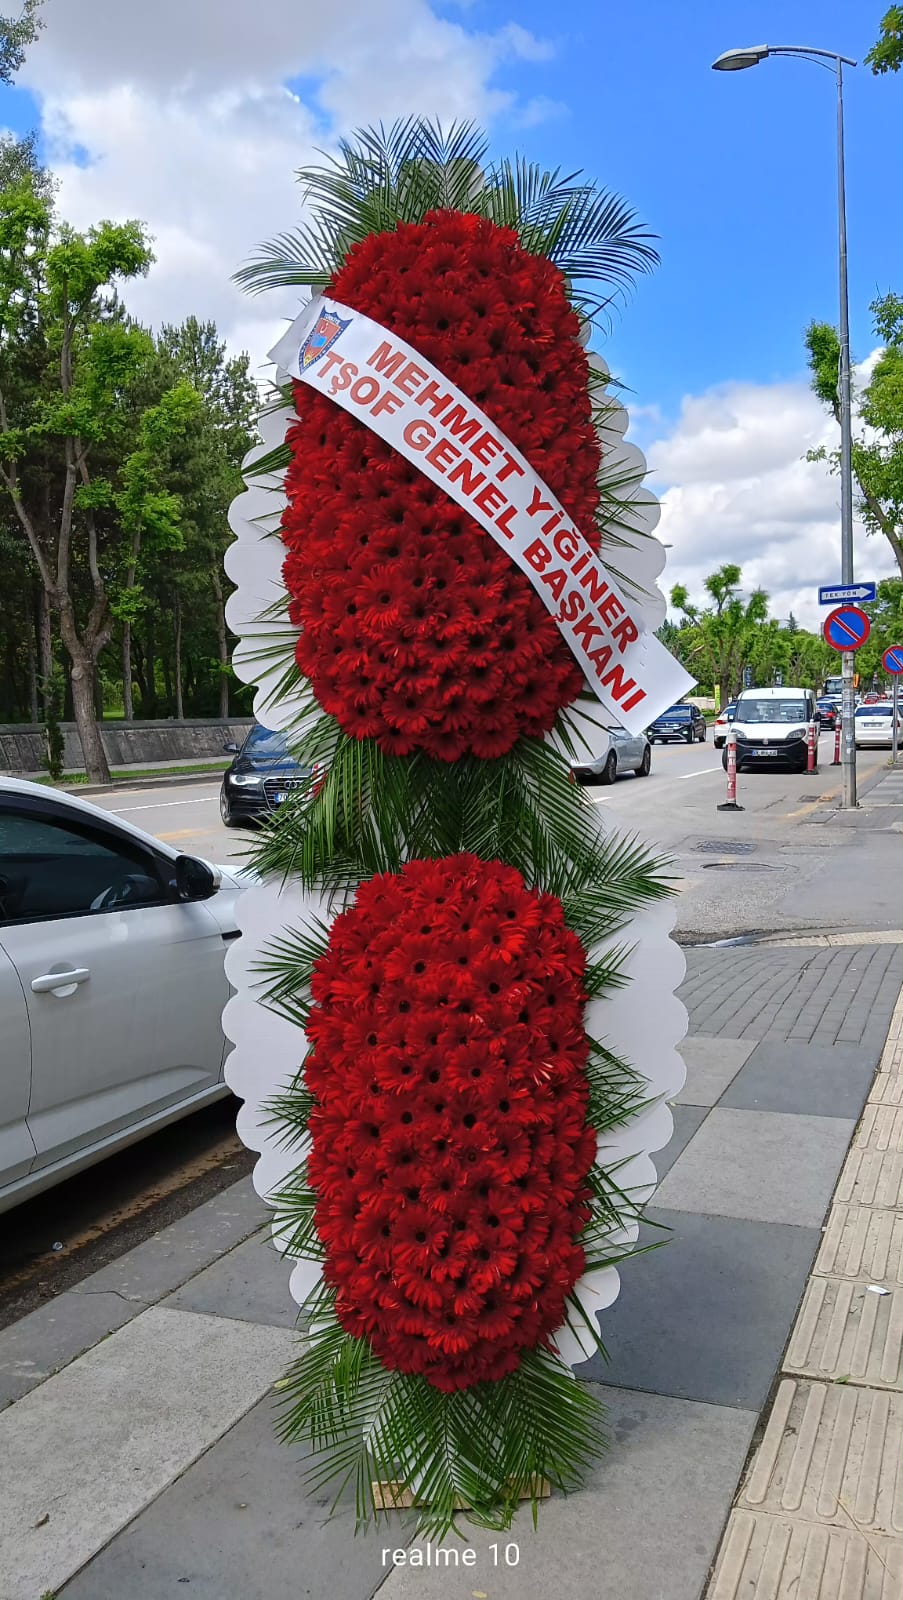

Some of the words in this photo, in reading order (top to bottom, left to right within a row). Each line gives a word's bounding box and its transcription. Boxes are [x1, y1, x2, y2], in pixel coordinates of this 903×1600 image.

[316, 351, 405, 417] TŞOF
[403, 419, 520, 540] GENEL
[523, 538, 647, 712] BAŞKANI
[367, 341, 525, 481] MEHMET
[526, 486, 639, 654] YİĞİNER
